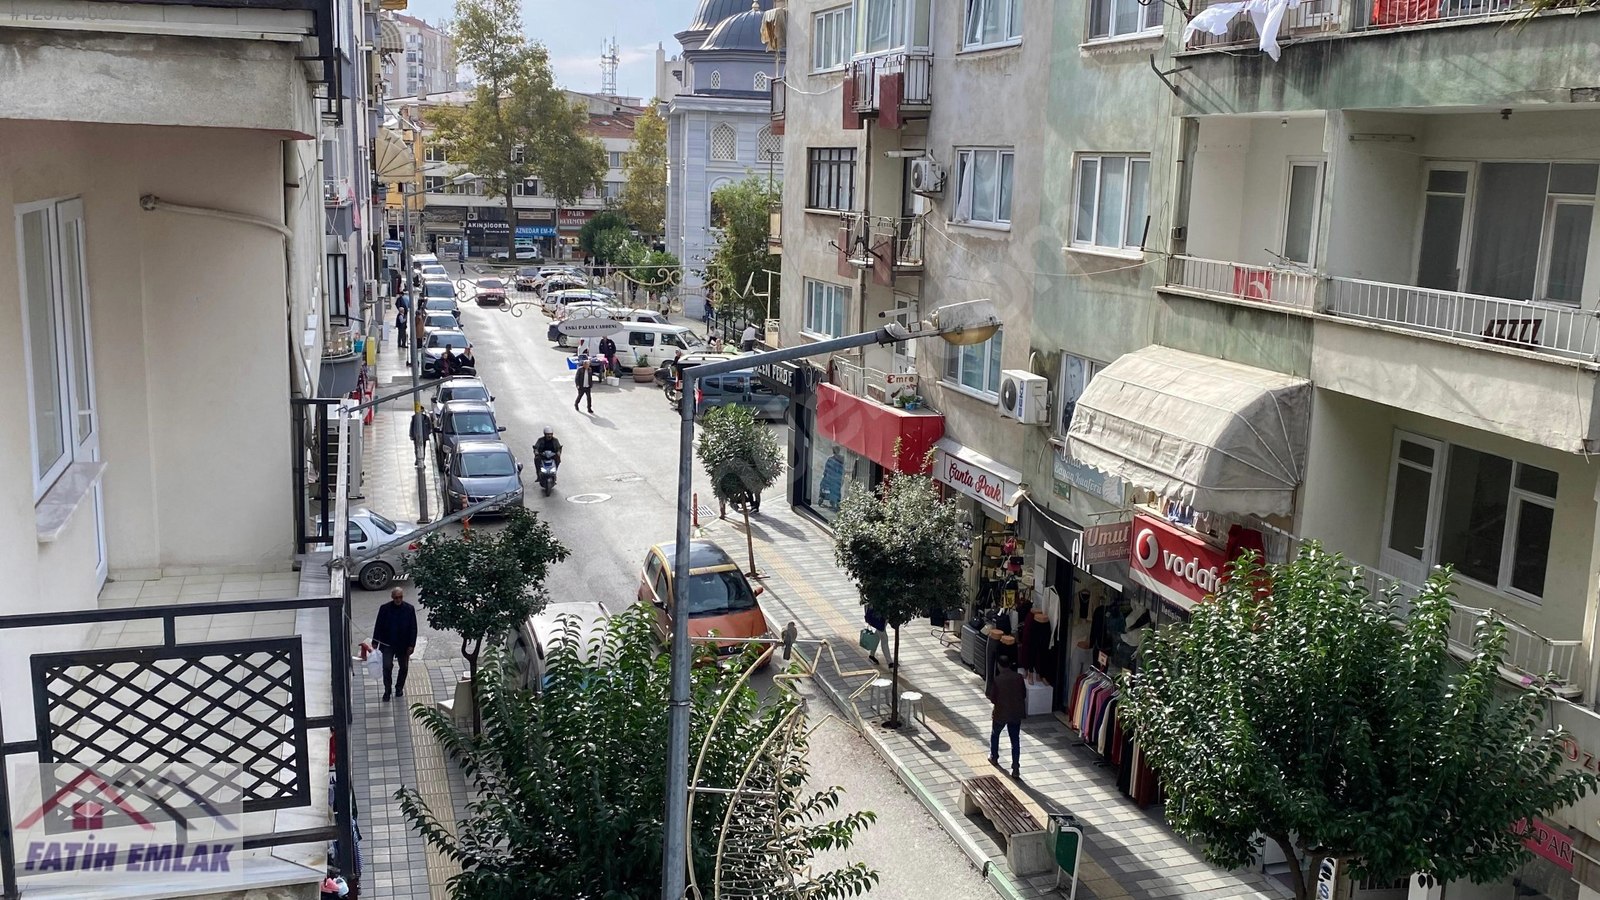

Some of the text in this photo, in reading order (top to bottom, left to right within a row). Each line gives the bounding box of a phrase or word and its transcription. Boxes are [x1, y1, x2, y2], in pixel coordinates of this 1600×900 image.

[887, 374, 914, 384] Emre
[949, 462, 1002, 502] Çanta Park
[1085, 525, 1130, 547] Umut
[1163, 550, 1222, 594] vodaf
